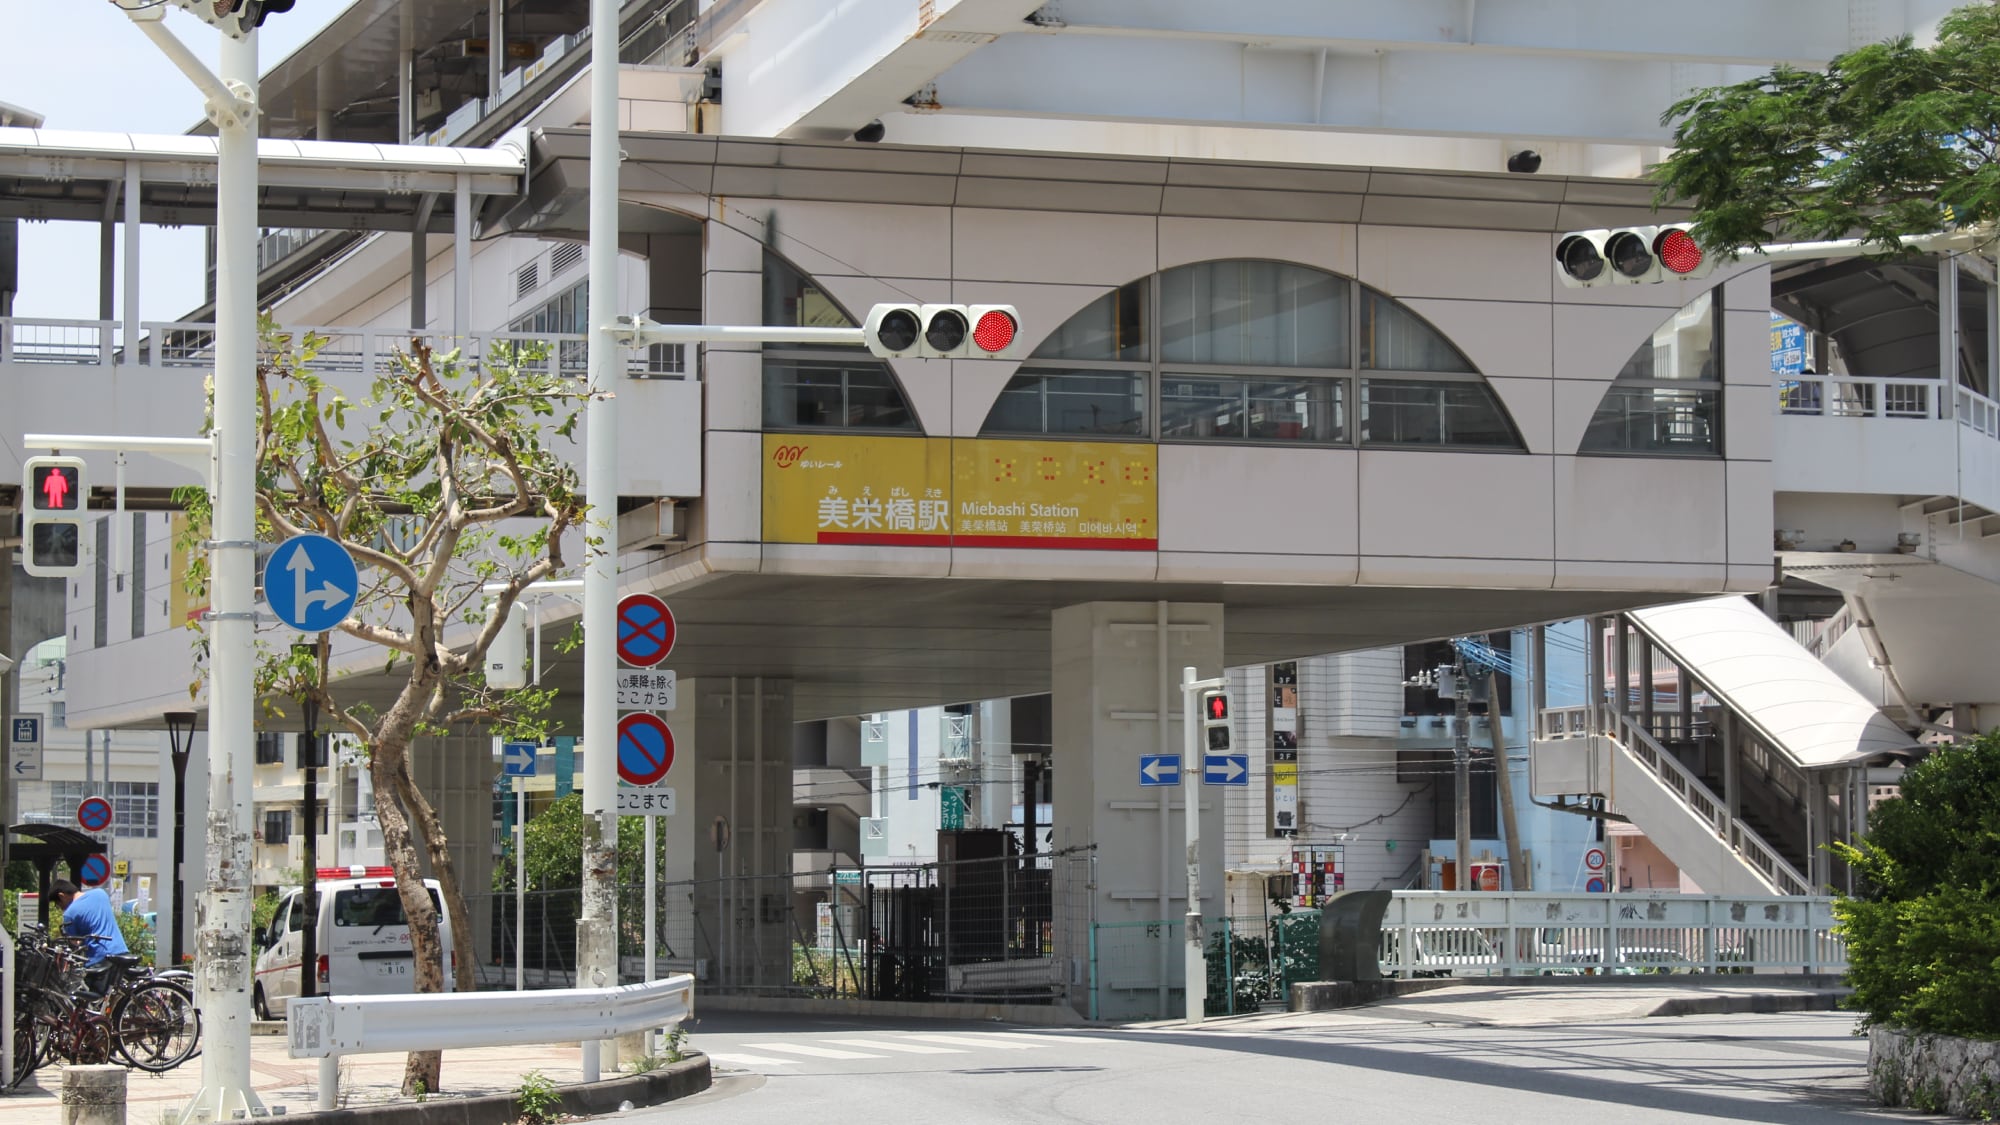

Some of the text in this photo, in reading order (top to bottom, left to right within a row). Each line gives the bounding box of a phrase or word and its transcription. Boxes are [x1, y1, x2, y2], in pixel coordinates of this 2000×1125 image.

[828, 486, 943, 498] み え ばし えき
[818, 496, 949, 531] 美栄橋駅
[961, 501, 1079, 518] Miebashi Station
[1080, 522, 1137, 535] 미에바시역
[617, 691, 668, 705] ここから
[617, 793, 669, 809] ここまで
[1590, 855, 1601, 865] 20
